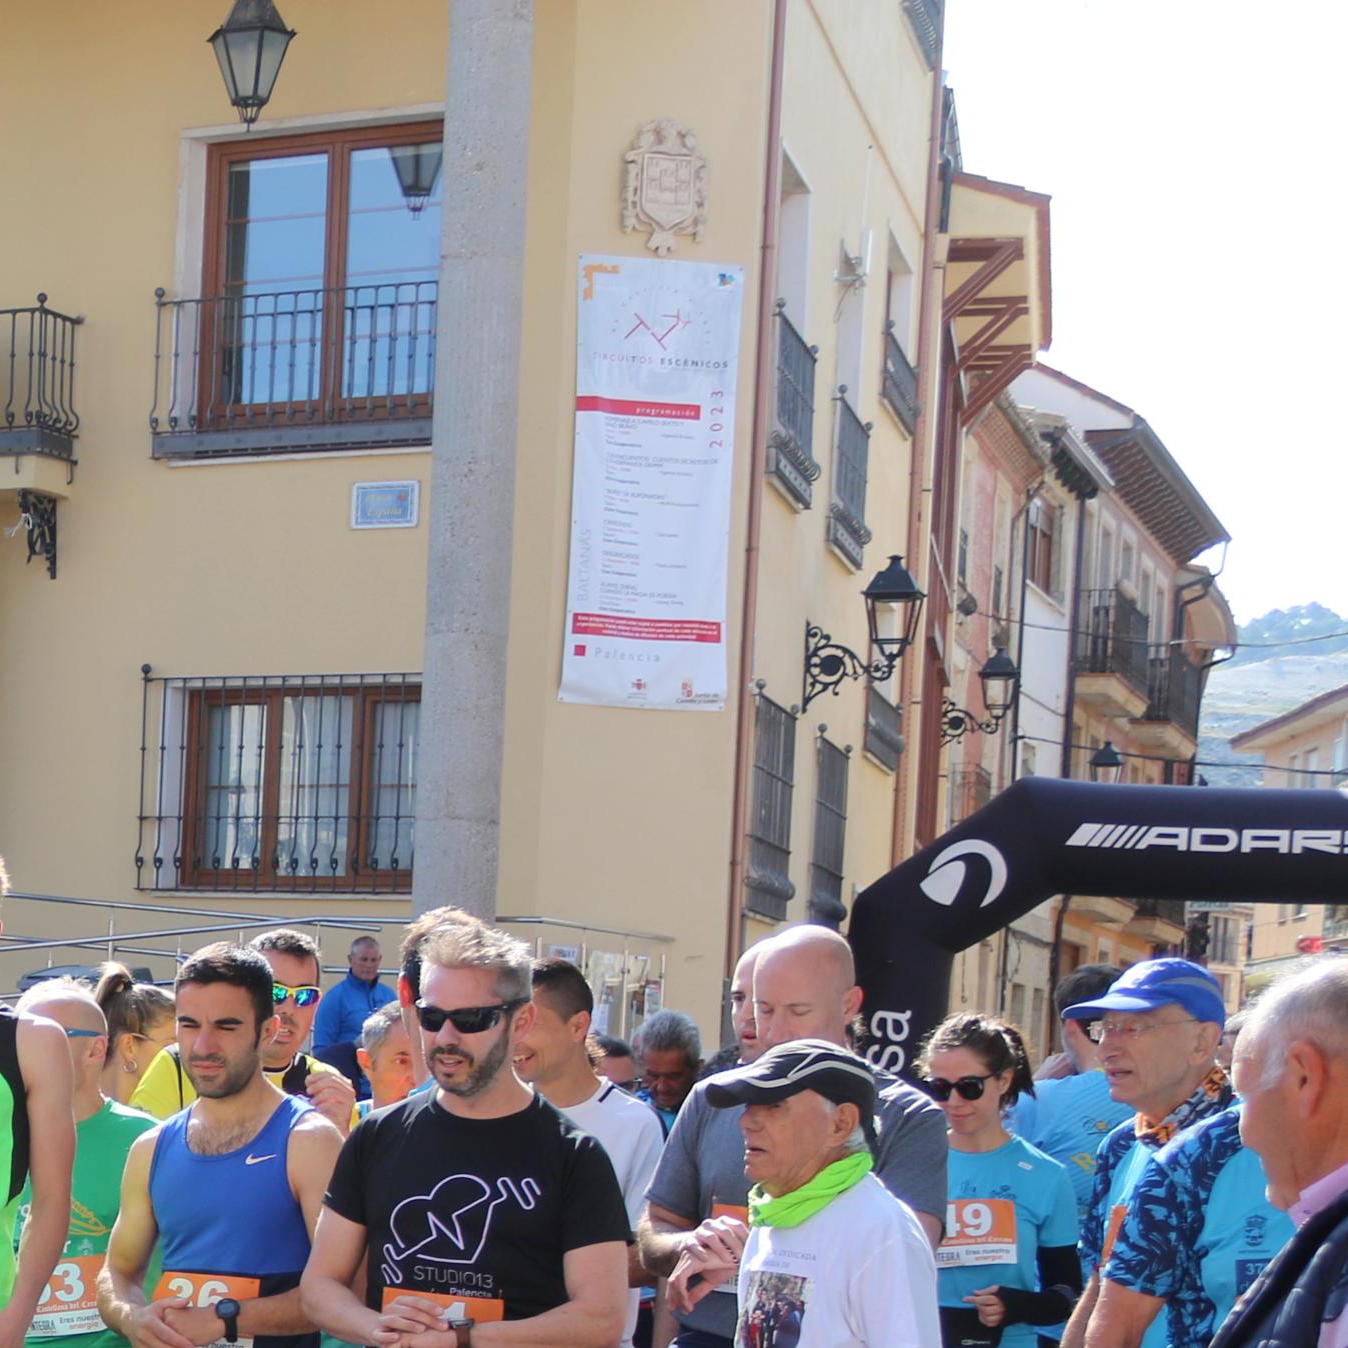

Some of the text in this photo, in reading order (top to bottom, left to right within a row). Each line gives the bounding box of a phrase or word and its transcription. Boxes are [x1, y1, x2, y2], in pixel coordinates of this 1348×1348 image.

[709, 390, 724, 448] 2023
[595, 647, 660, 663] Palencia
[1135, 826, 1348, 855] ADAR
[937, 1251, 960, 1263] TEGRA
[413, 1265, 494, 1289] STUDIO13
[31, 1319, 56, 1331] NTEGRA
[59, 1313, 99, 1324] Eres nuestr
